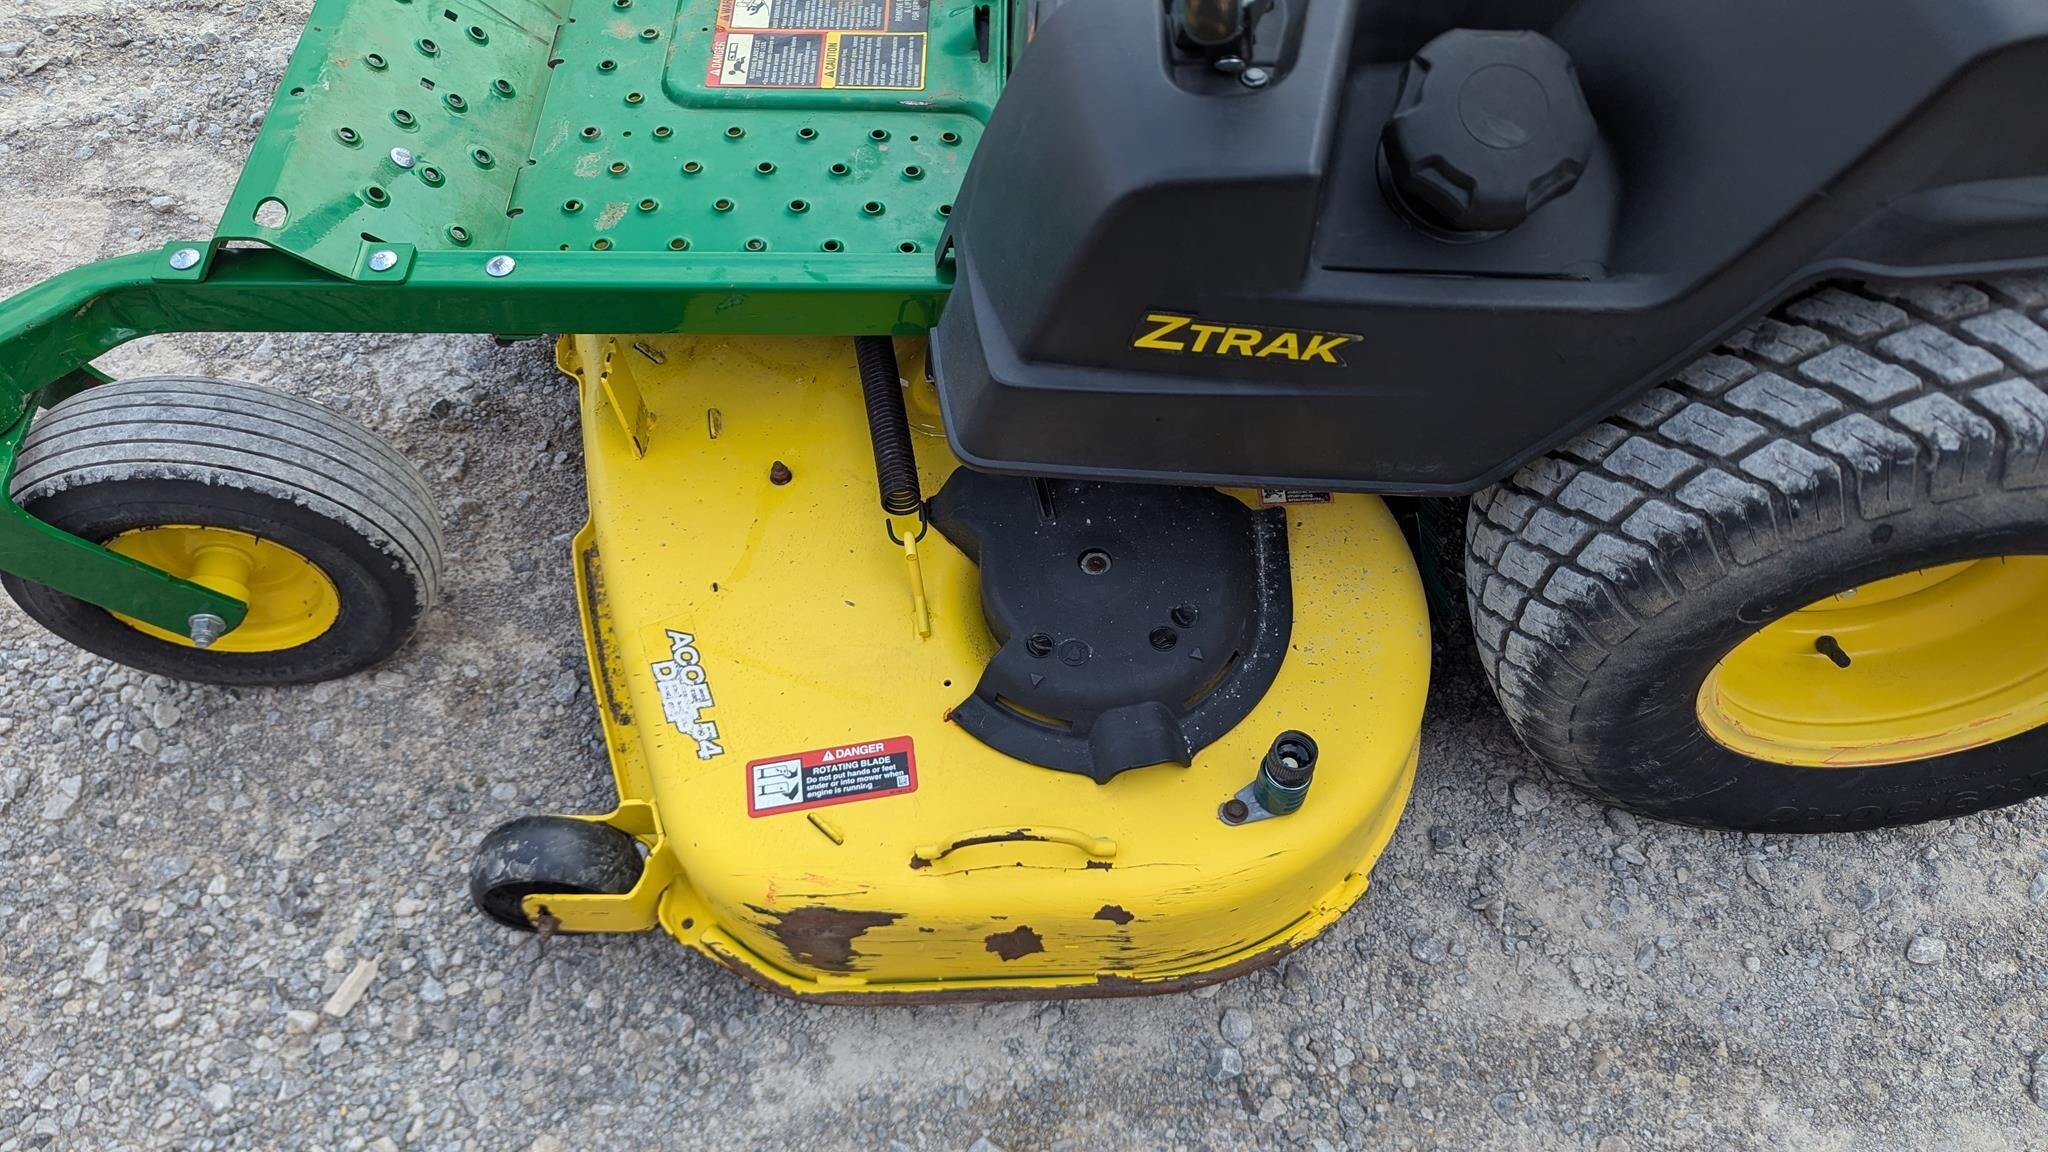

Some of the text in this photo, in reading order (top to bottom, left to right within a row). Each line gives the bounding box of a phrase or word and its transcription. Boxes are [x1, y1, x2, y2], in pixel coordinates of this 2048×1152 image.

[826, 43, 838, 70] CAUTION
[1134, 314, 1349, 363] ZTRAK
[666, 629, 725, 759] ACCEL 54
[836, 743, 884, 758] DANGER
[813, 756, 890, 774] ROTATING BLADE
[833, 773, 845, 781] put
[847, 769, 870, 777] hands
[882, 764, 896, 772] feet
[857, 775, 882, 783] mower
[884, 771, 904, 779] when
[807, 790, 833, 798] engine
